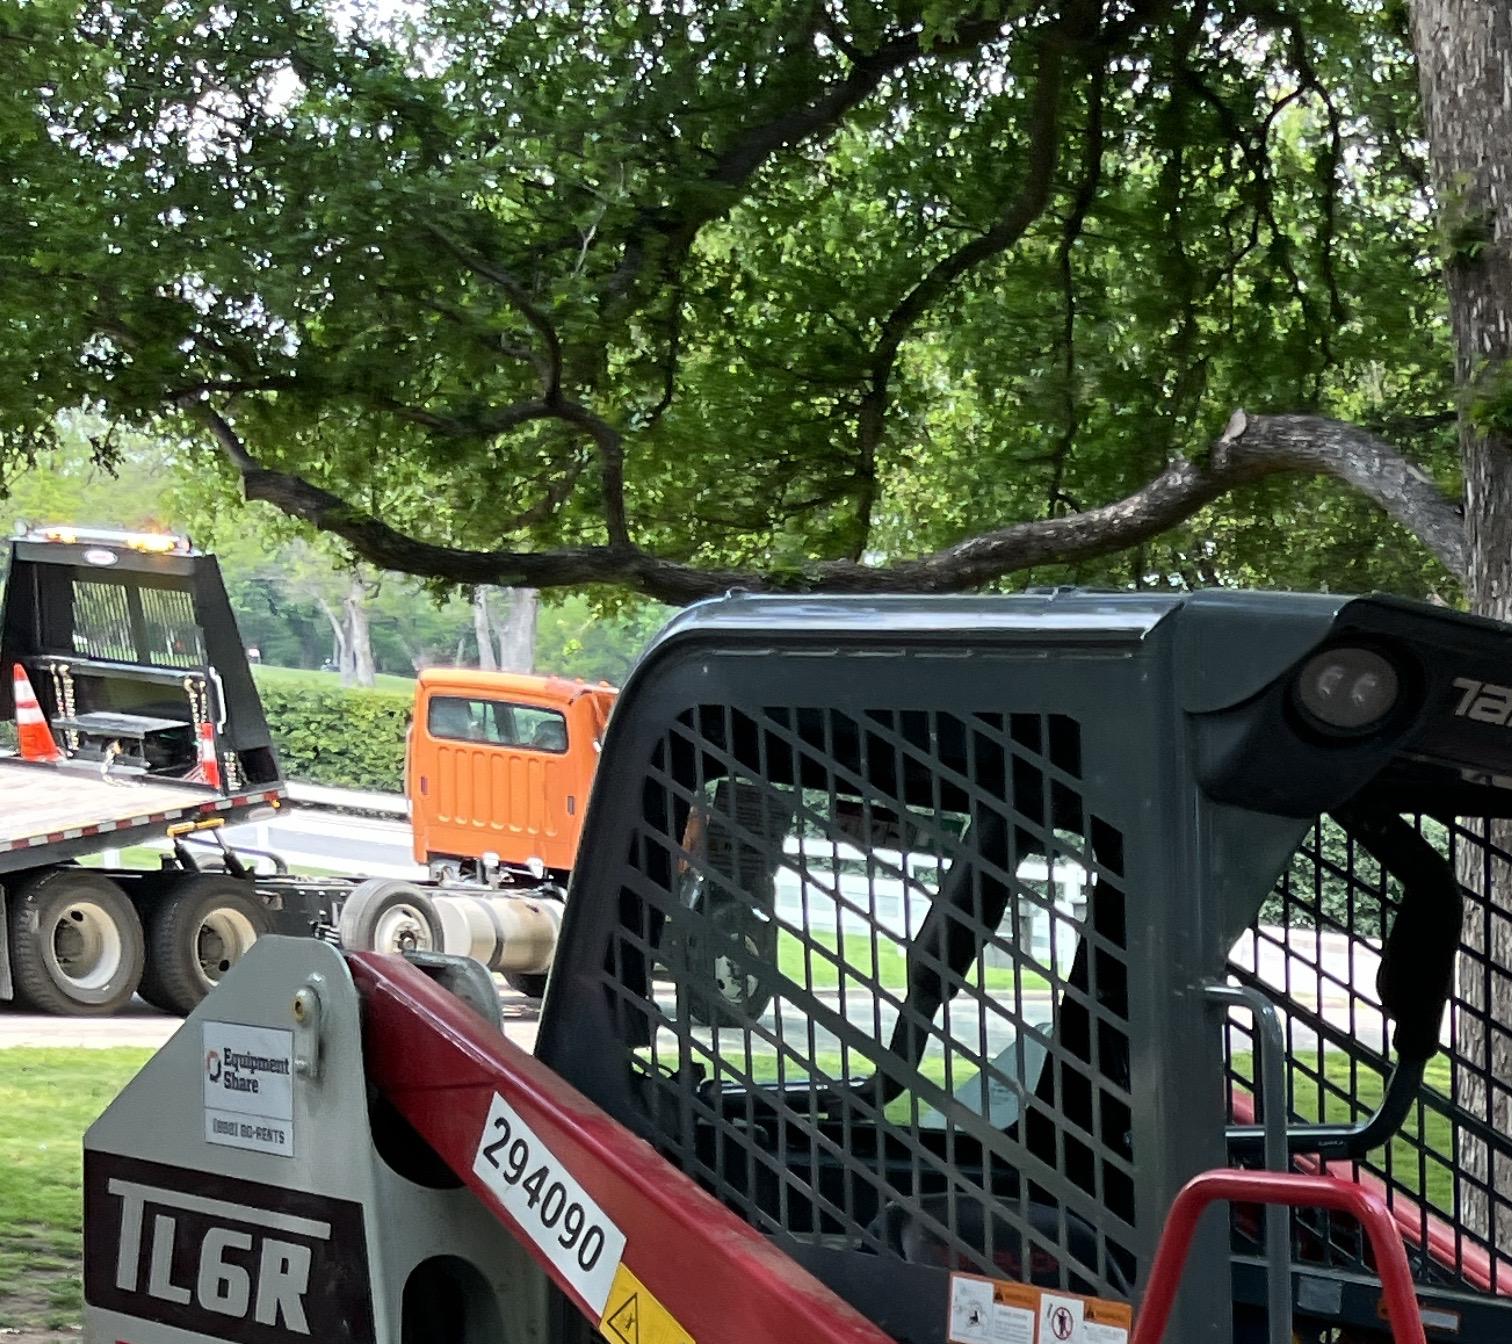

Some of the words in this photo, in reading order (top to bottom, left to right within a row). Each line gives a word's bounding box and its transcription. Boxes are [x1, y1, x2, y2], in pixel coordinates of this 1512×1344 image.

[223, 1047, 290, 1076] Equipment
[223, 1070, 260, 1094] Share
[482, 1116, 606, 1272] 294090
[107, 1177, 332, 1336] TL6R
